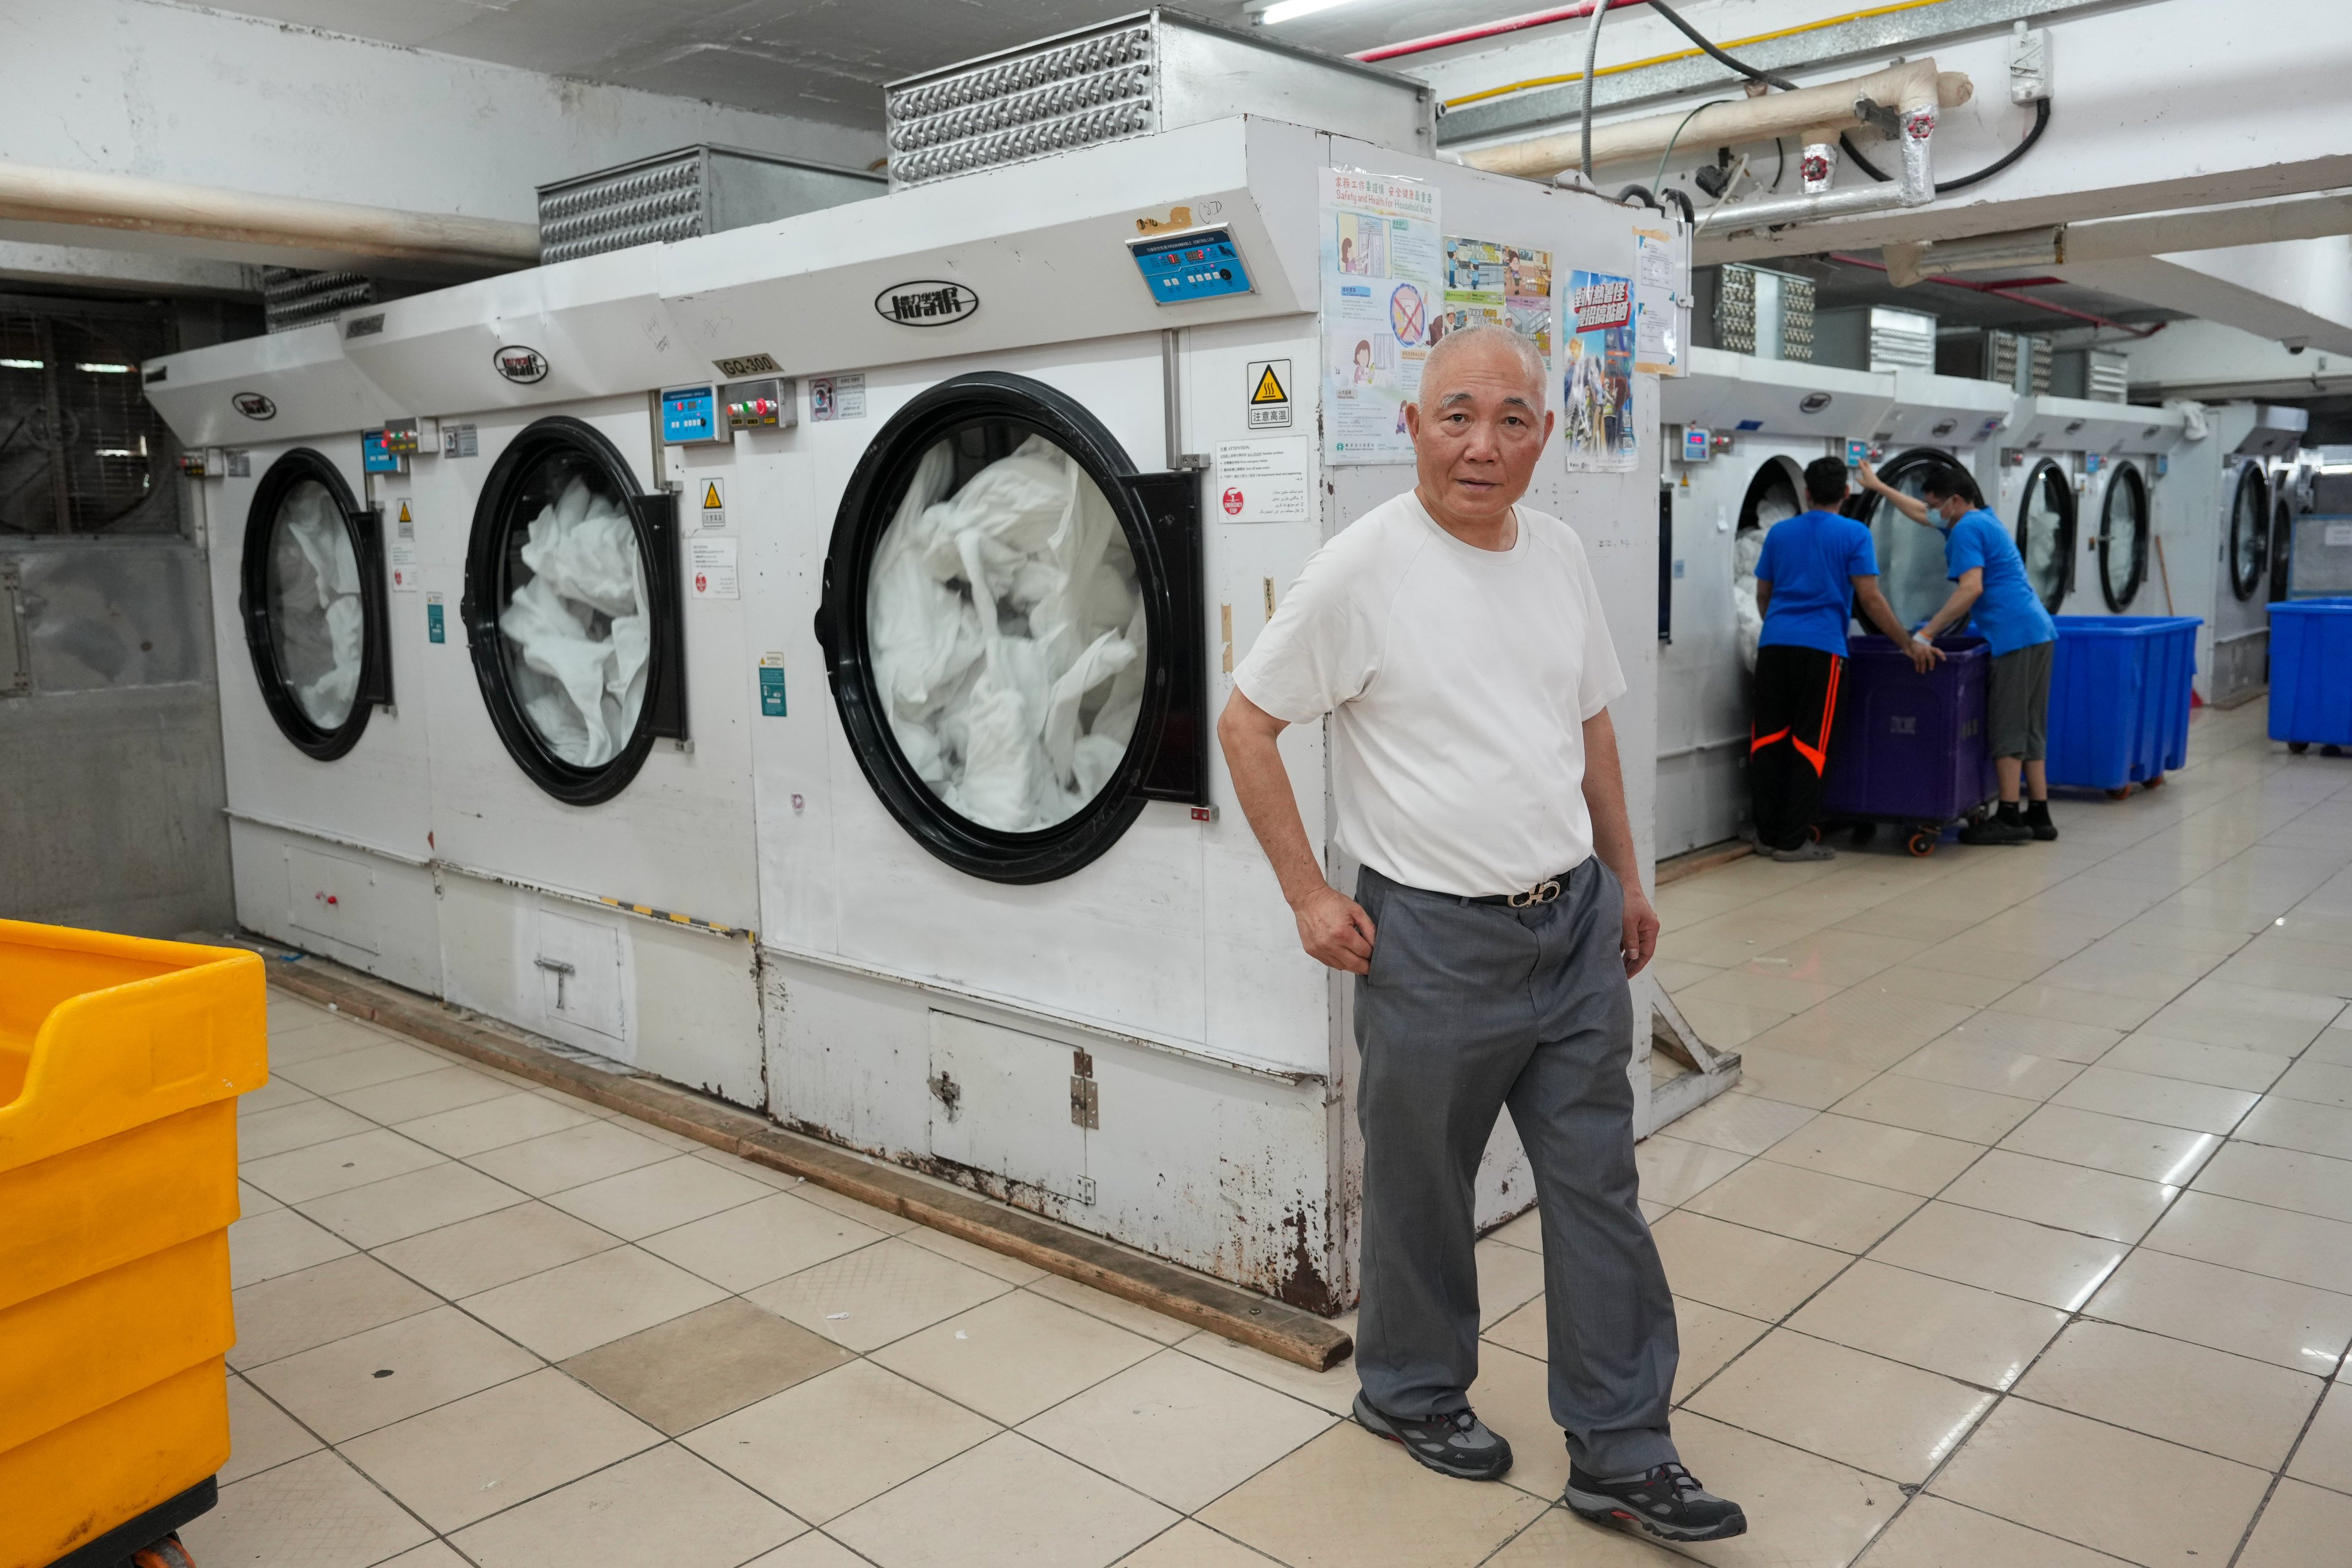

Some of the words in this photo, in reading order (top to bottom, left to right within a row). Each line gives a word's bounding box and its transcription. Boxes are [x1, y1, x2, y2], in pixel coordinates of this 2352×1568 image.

[1337, 189, 1357, 204] Safety
[1358, 194, 1368, 203] and
[1369, 194, 1385, 206] Health
[1385, 198, 1393, 207] for
[1395, 199, 1419, 212] Household
[1420, 204, 1432, 215] Work
[724, 356, 773, 375] GQ-300
[1253, 410, 1287, 422] 注意高温
